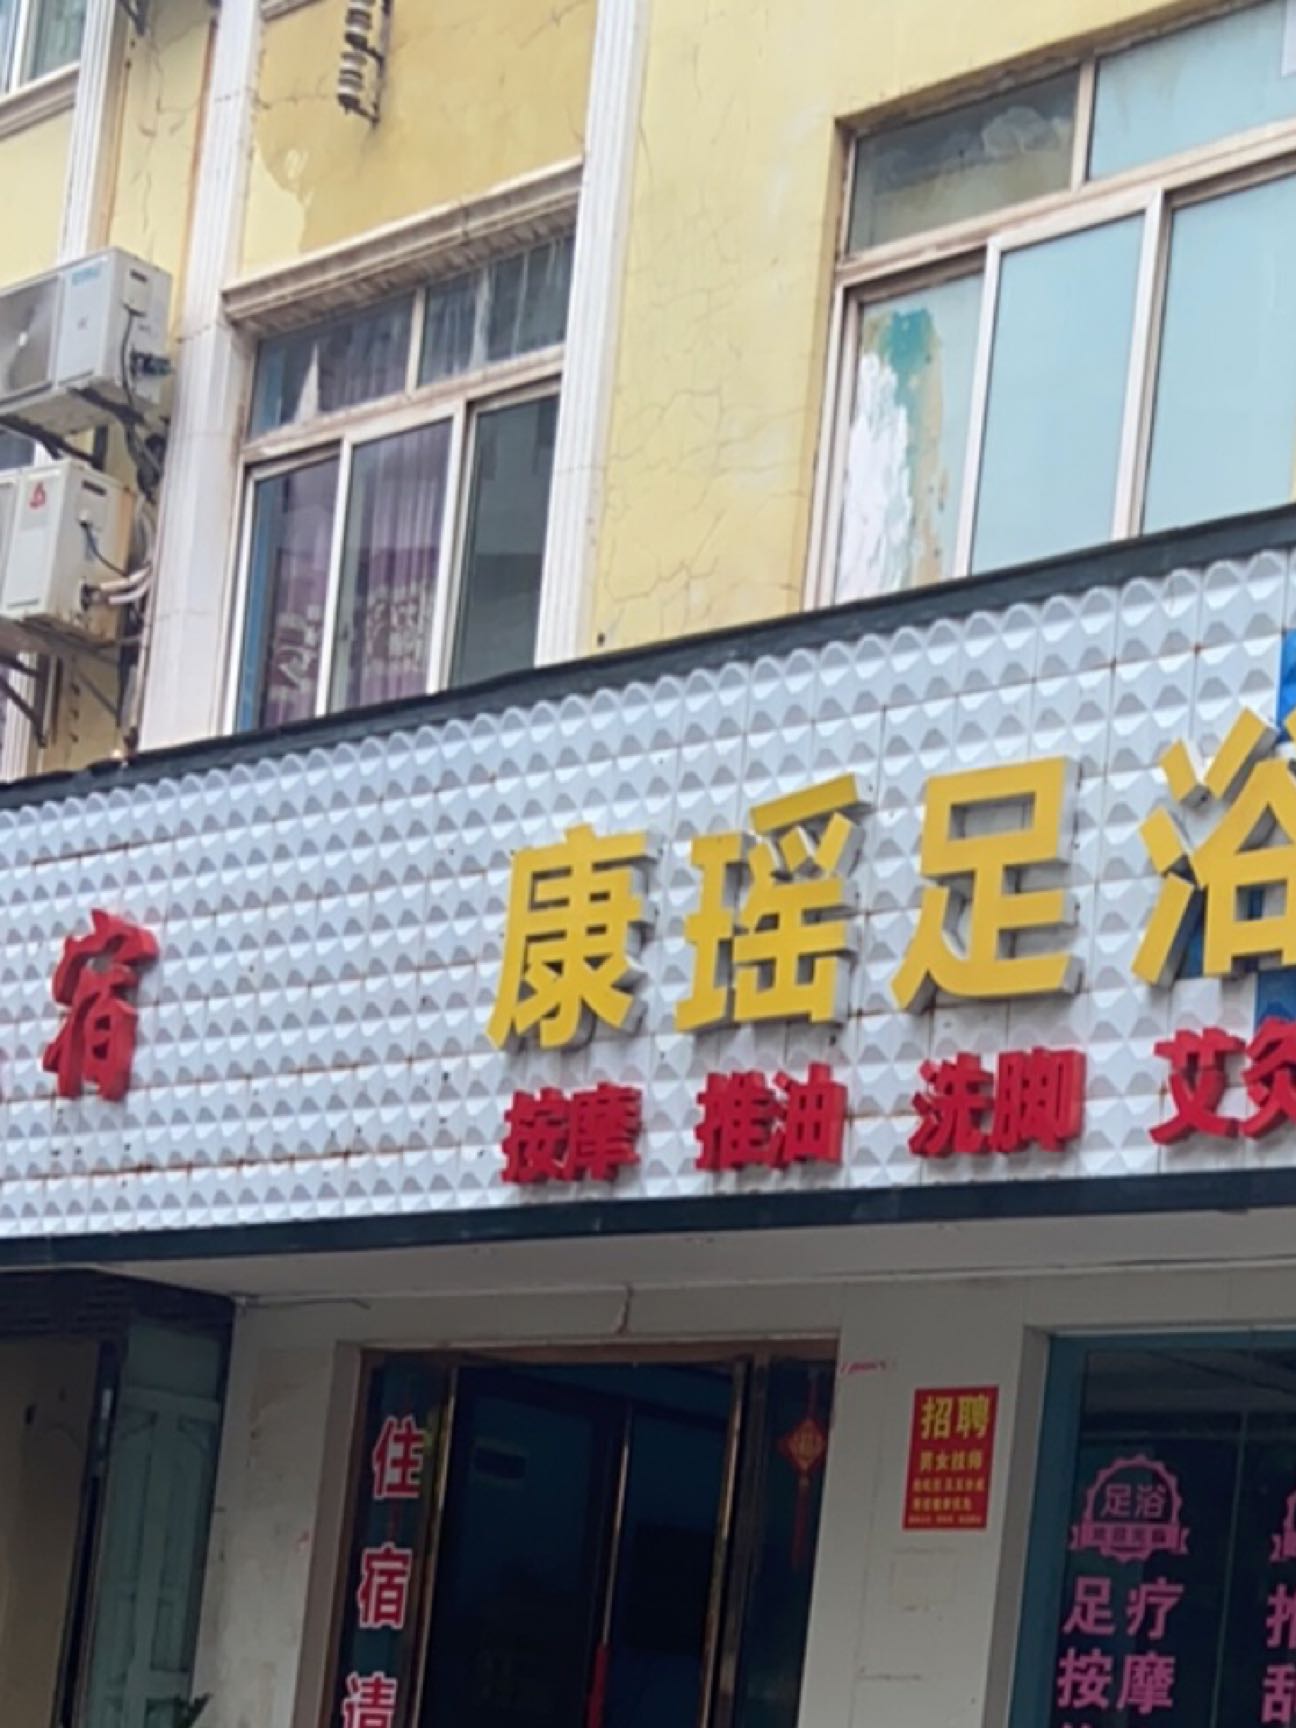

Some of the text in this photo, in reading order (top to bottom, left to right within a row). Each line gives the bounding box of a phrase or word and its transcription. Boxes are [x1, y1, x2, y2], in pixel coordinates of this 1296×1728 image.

[41, 909, 157, 1102] 宿
[501, 1082, 640, 1185] 按摩
[694, 1062, 847, 1171] 推油
[908, 1046, 1086, 1159] 洗脚
[919, 1393, 991, 1441] 招聘
[1100, 1482, 1168, 1519] 足浴
[1063, 1576, 1184, 1640] 足疗
[1056, 1648, 1176, 1715] 按摩
